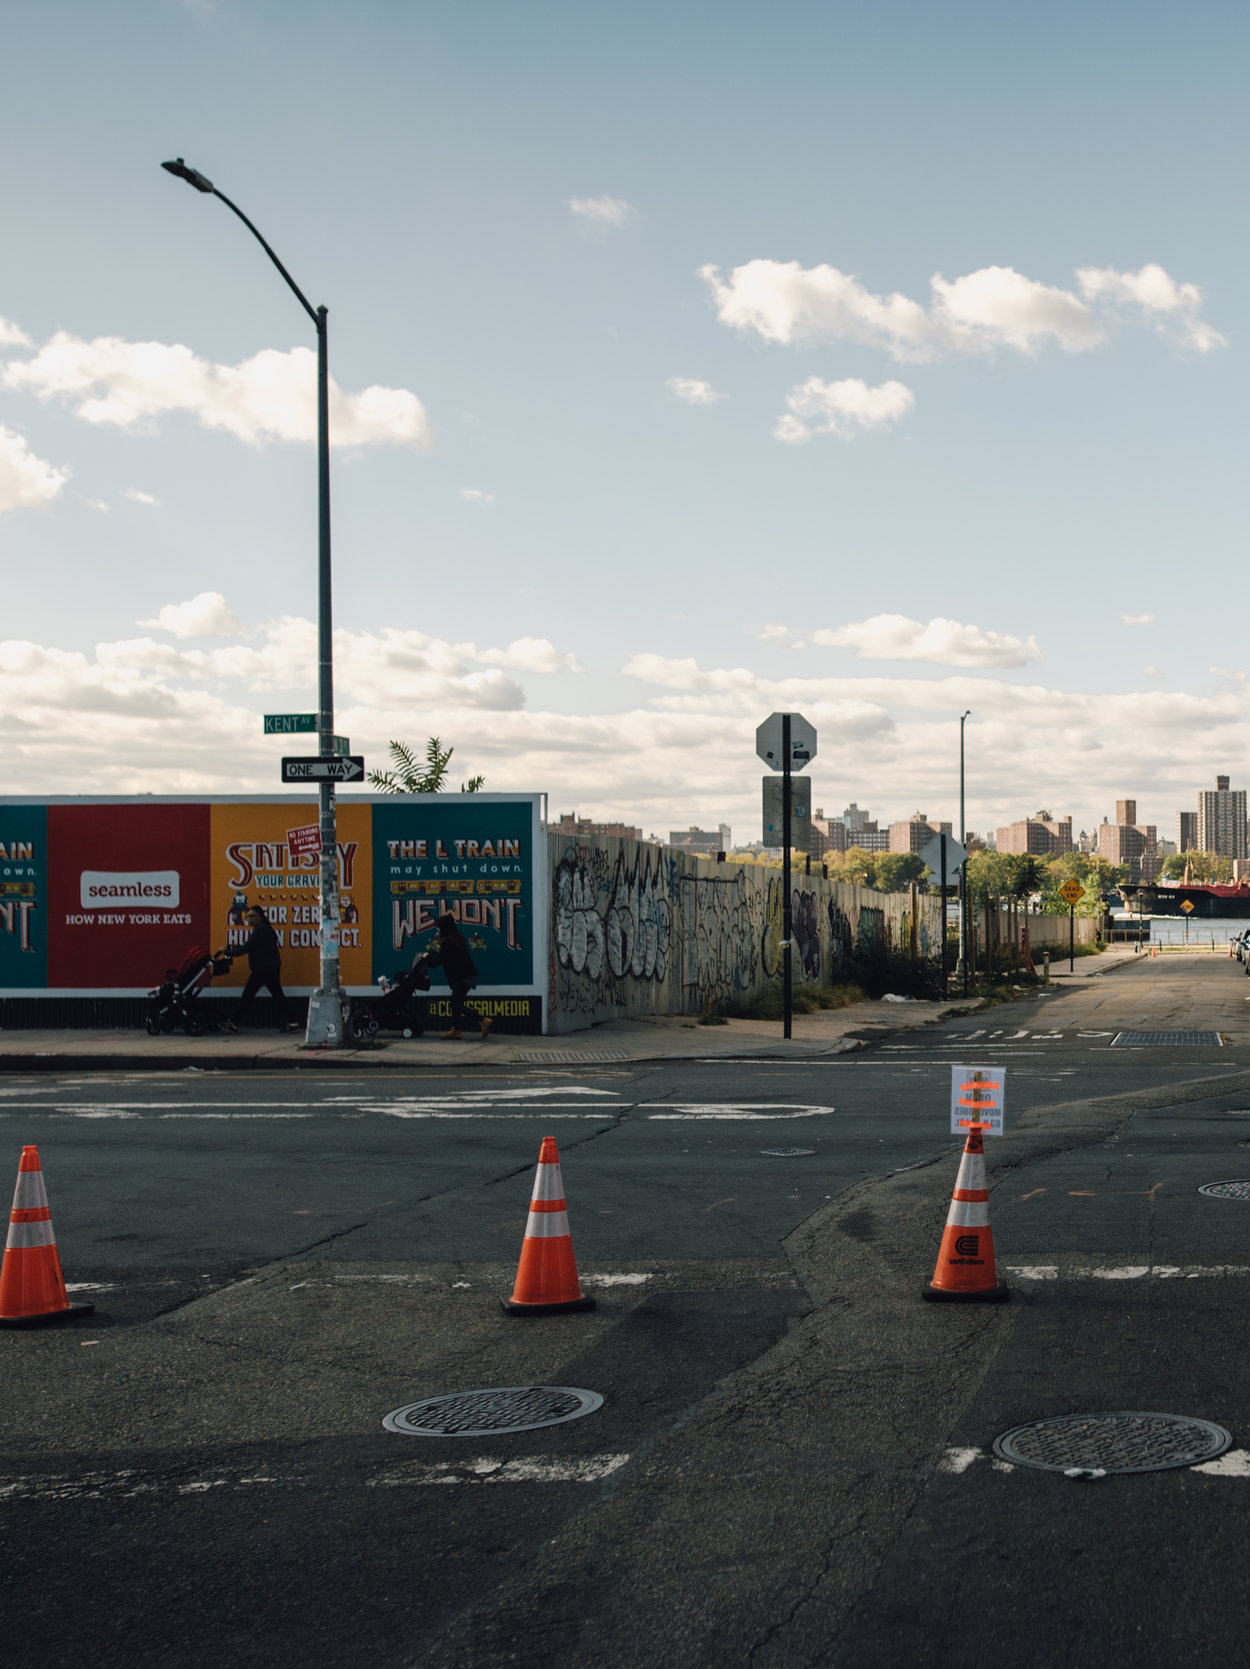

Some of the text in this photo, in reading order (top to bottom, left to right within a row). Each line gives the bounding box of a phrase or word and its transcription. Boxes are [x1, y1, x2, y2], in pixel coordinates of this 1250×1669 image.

[265, 716, 311, 733] KENT AV
[289, 764, 353, 775] ONE WAY
[297, 827, 319, 837] STANDING
[293, 836, 316, 845] ANYTIME
[387, 839, 521, 860] THE L TRAIN
[390, 863, 523, 876] may shut down.
[89, 881, 172, 897] seamless
[254, 875, 284, 889] YOUR
[65, 914, 192, 925] HOW NEW YORK EATS
[291, 905, 321, 924] ZER
[392, 898, 437, 951] WE
[228, 928, 284, 948] HUN
